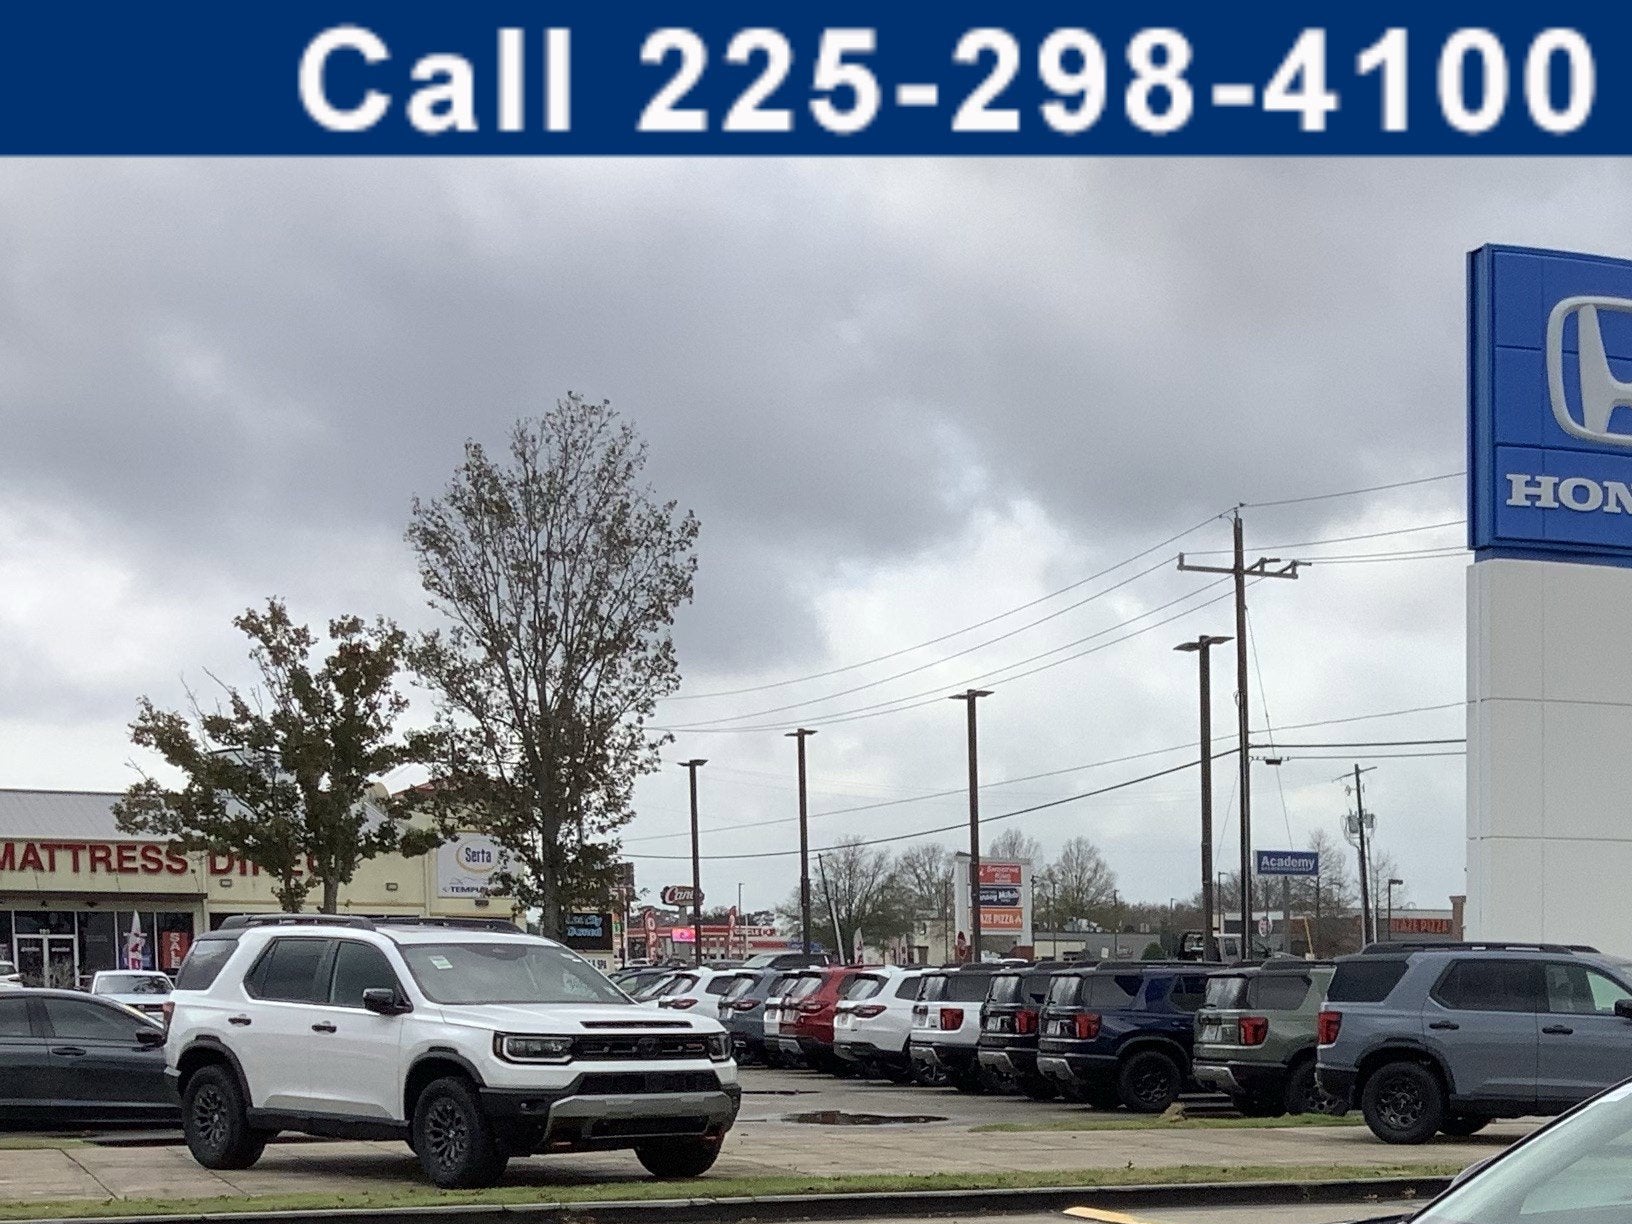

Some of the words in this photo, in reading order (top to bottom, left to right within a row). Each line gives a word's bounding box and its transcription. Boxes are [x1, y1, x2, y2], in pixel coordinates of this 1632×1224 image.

[465, 847, 492, 863] Serta
[1261, 855, 1315, 871] Academy
[170, 931, 182, 968] SALE
